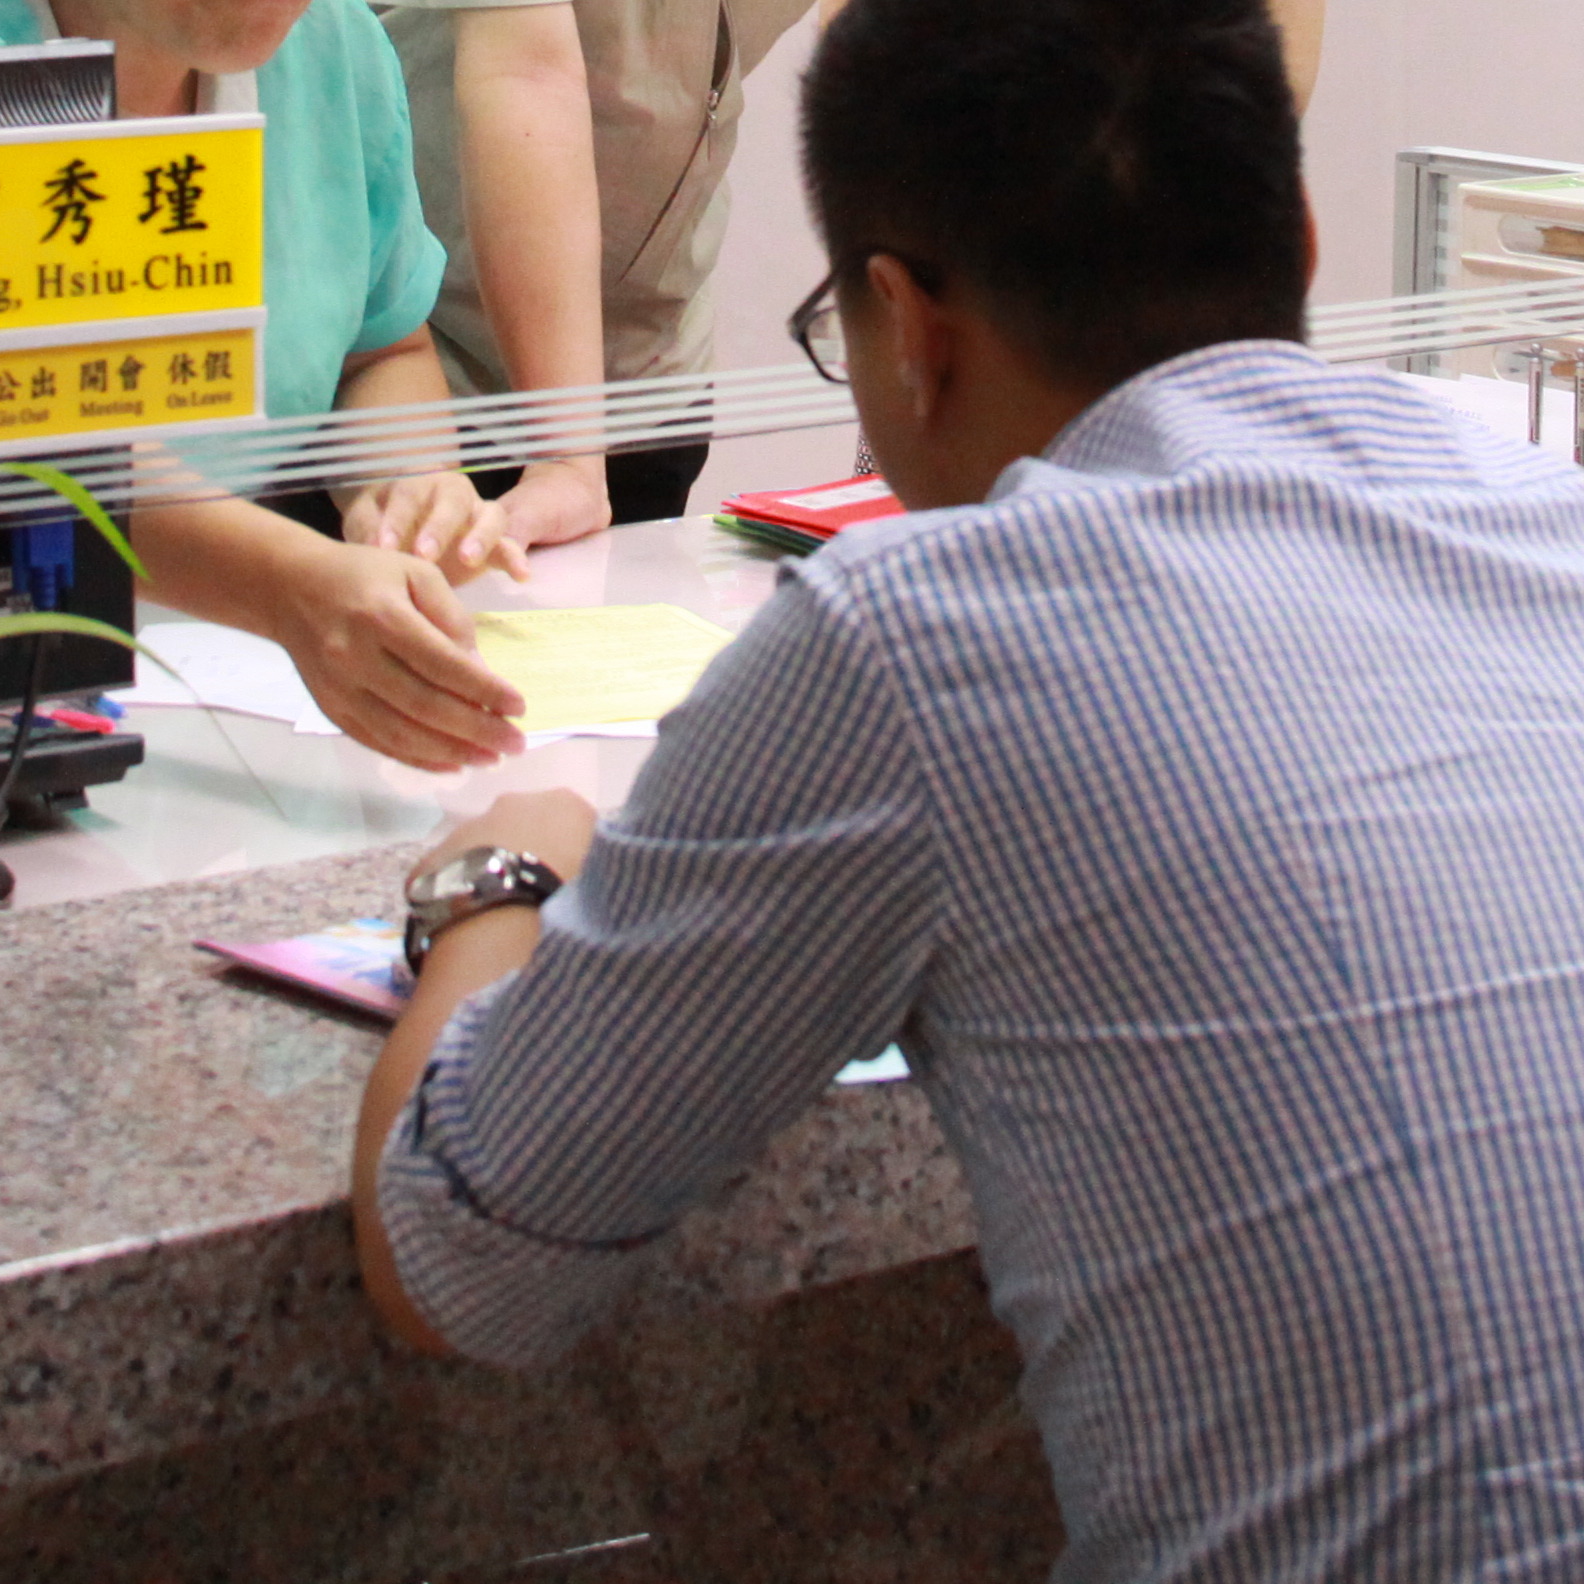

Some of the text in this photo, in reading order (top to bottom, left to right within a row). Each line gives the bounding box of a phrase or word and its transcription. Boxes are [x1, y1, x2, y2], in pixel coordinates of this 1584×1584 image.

[36, 251, 234, 300] Hsiu-Chin
[79, 355, 146, 393] 開會
[166, 350, 233, 386] 休假
